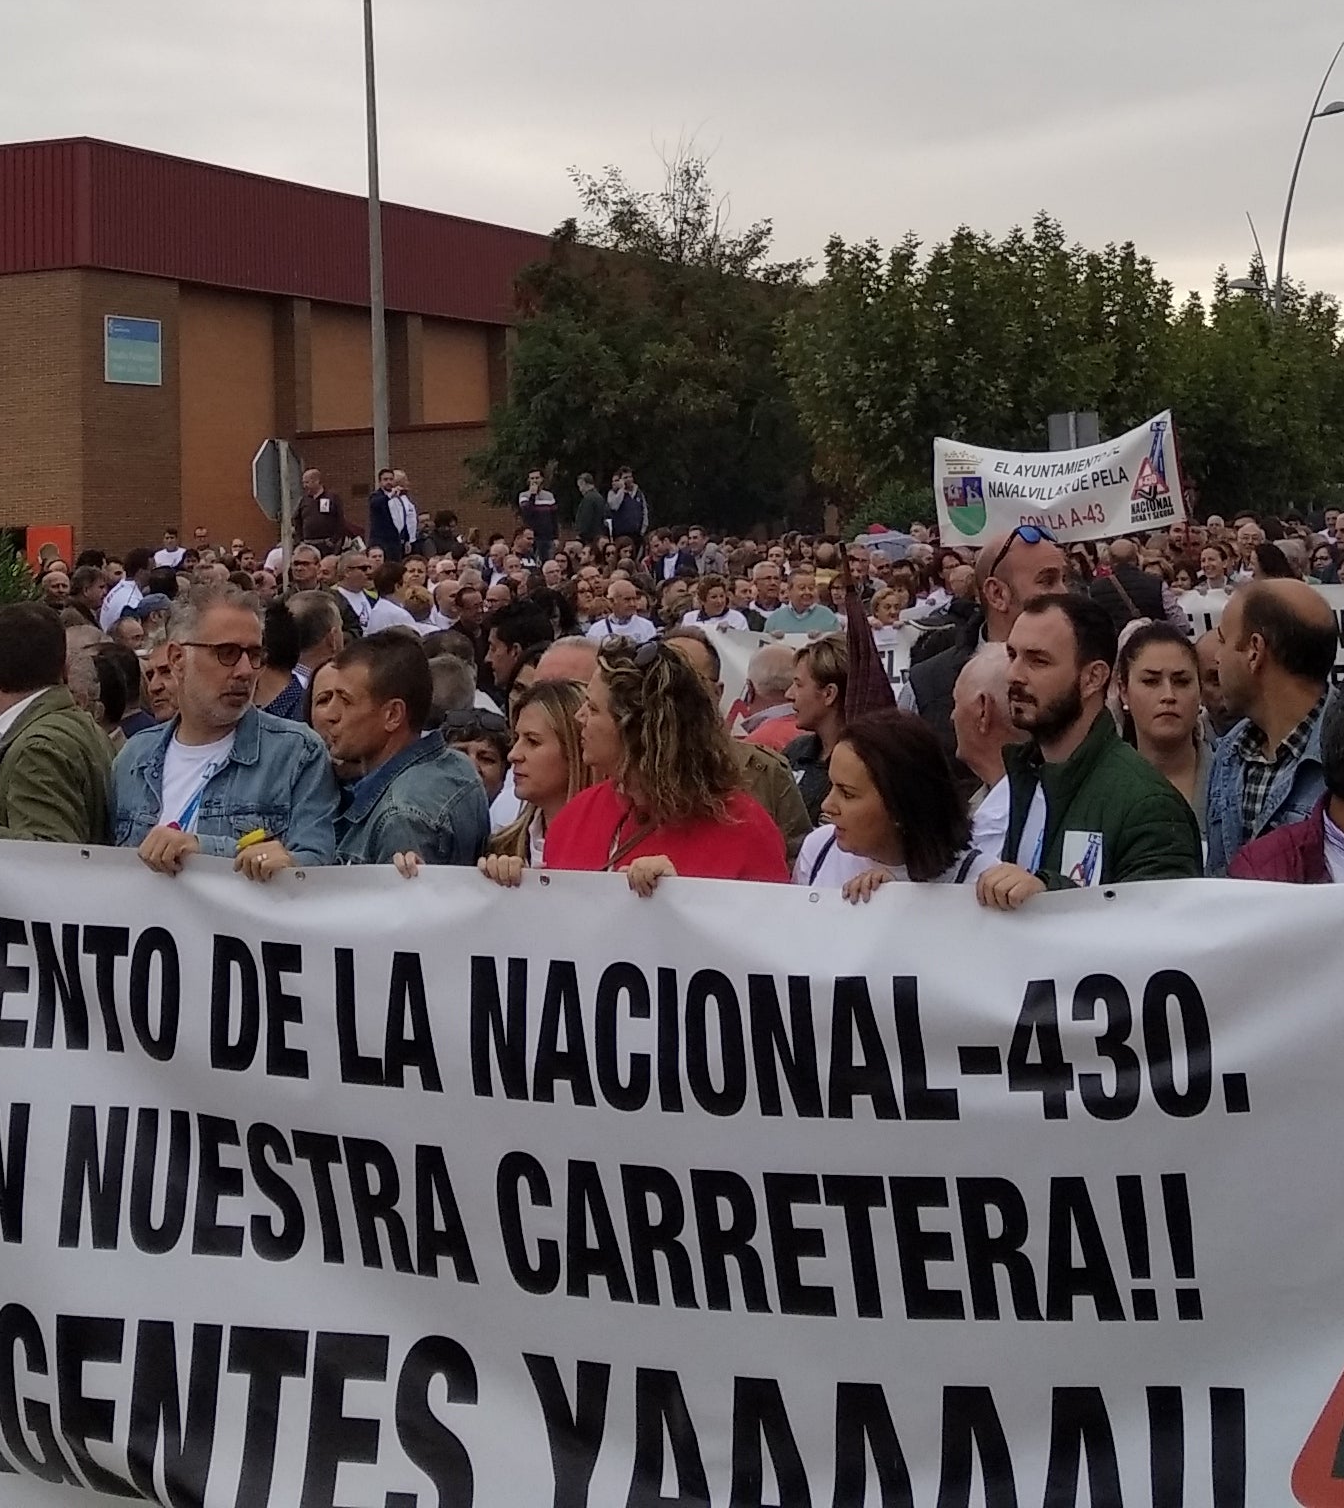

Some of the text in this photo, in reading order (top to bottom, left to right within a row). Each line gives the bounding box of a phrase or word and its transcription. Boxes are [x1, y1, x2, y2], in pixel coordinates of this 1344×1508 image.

[994, 461, 1010, 475] EL
[1091, 467, 1129, 488] PELA
[1048, 512, 1067, 529] LA
[1071, 503, 1105, 528] A-43
[1131, 496, 1173, 514] NACIONAL
[210, 933, 310, 1080] DE
[335, 947, 444, 1094] LA
[471, 955, 1251, 1121] NACIONAL-430.
[59, 1104, 480, 1285] NUESTRA
[497, 1150, 1204, 1322] CARRETERA!!
